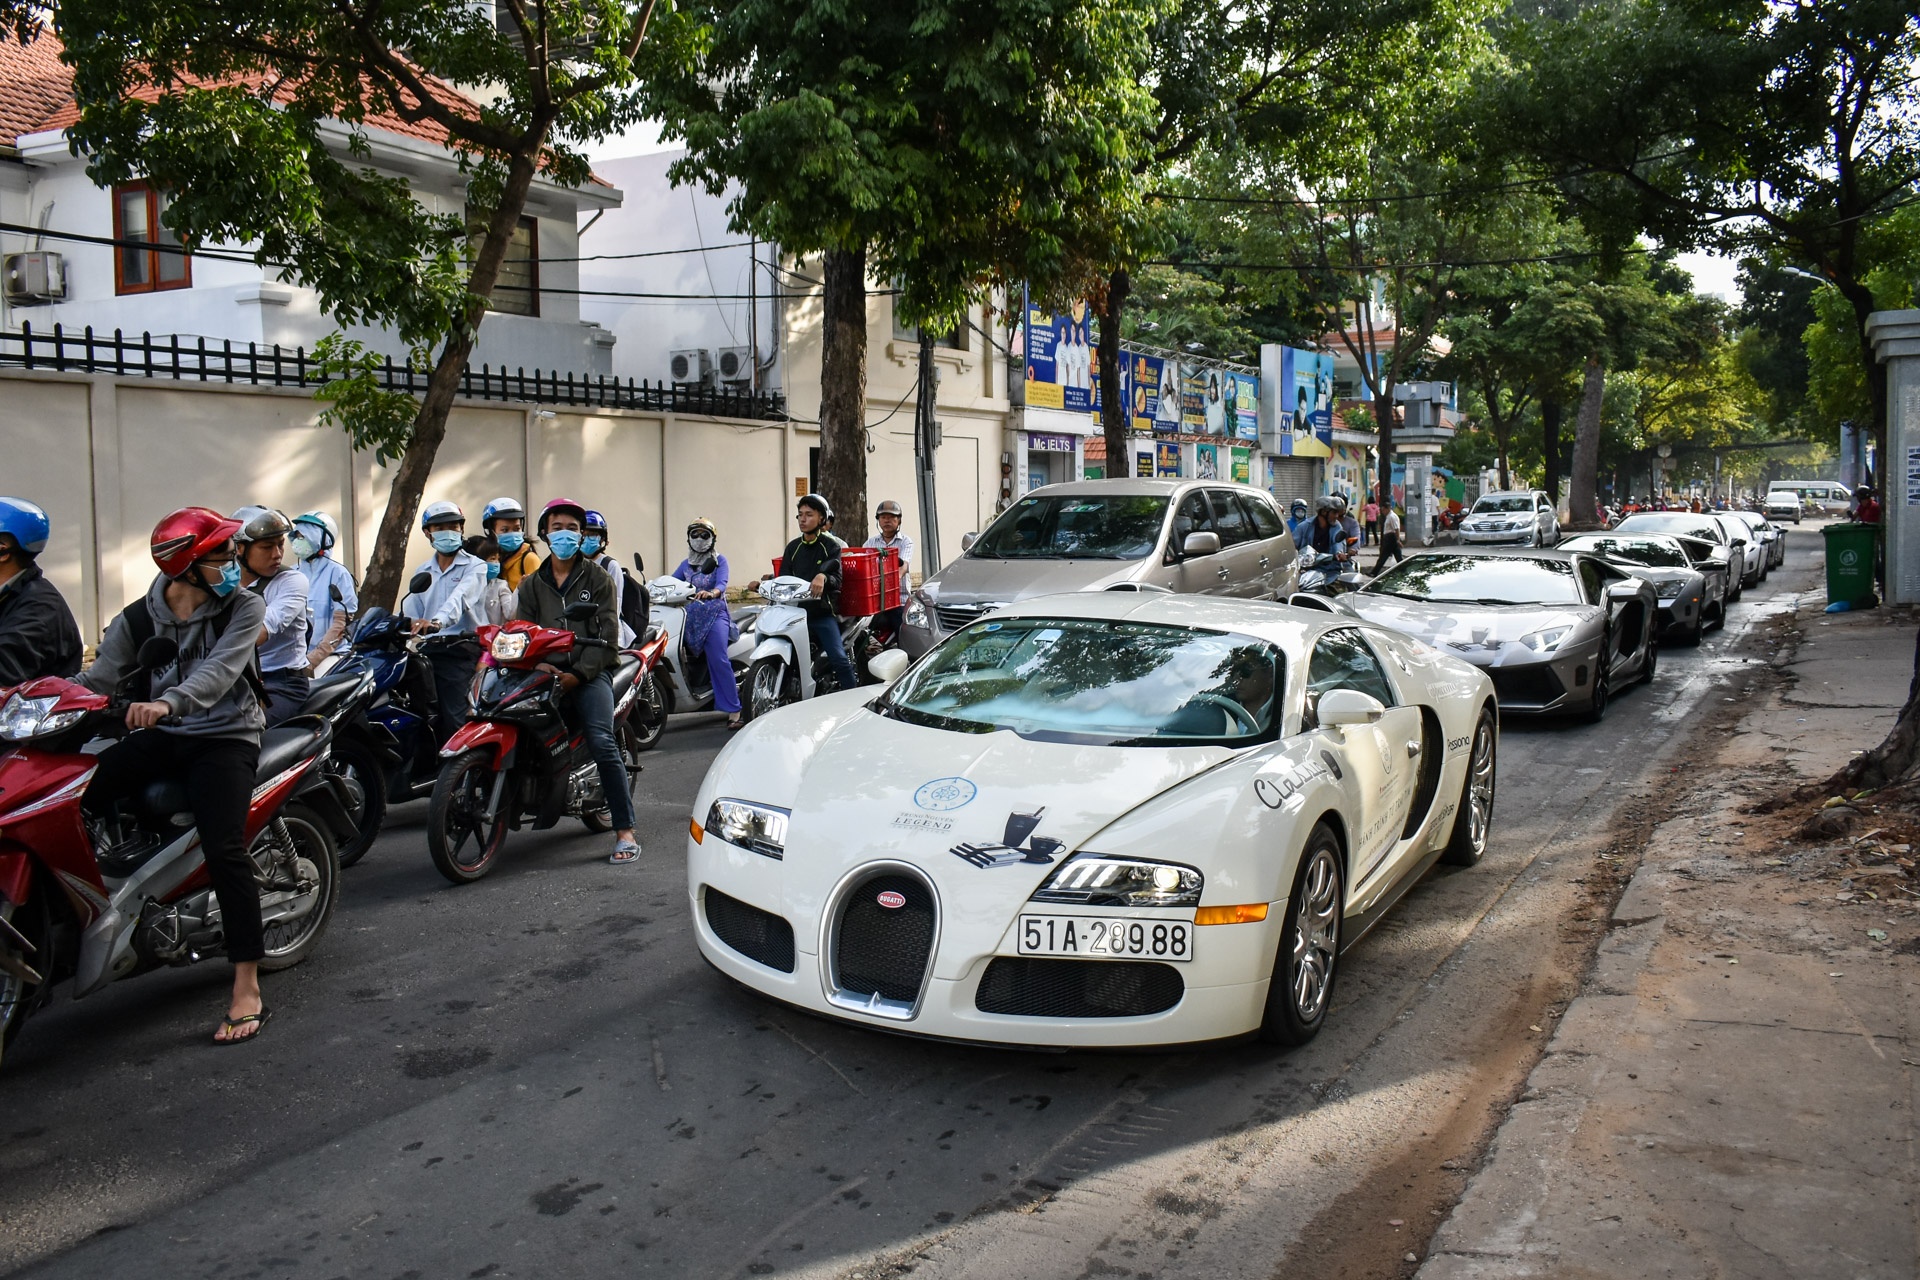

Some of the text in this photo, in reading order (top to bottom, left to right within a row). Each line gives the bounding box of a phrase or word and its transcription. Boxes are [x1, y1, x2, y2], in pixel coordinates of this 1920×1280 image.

[1033, 438, 1070, 451] Mc IELTS
[1114, 625, 1187, 637] COFFEE
[895, 817, 952, 830] LEGEND
[880, 895, 903, 905] BUGATTI
[1025, 919, 1187, 956] 51A-289.88
